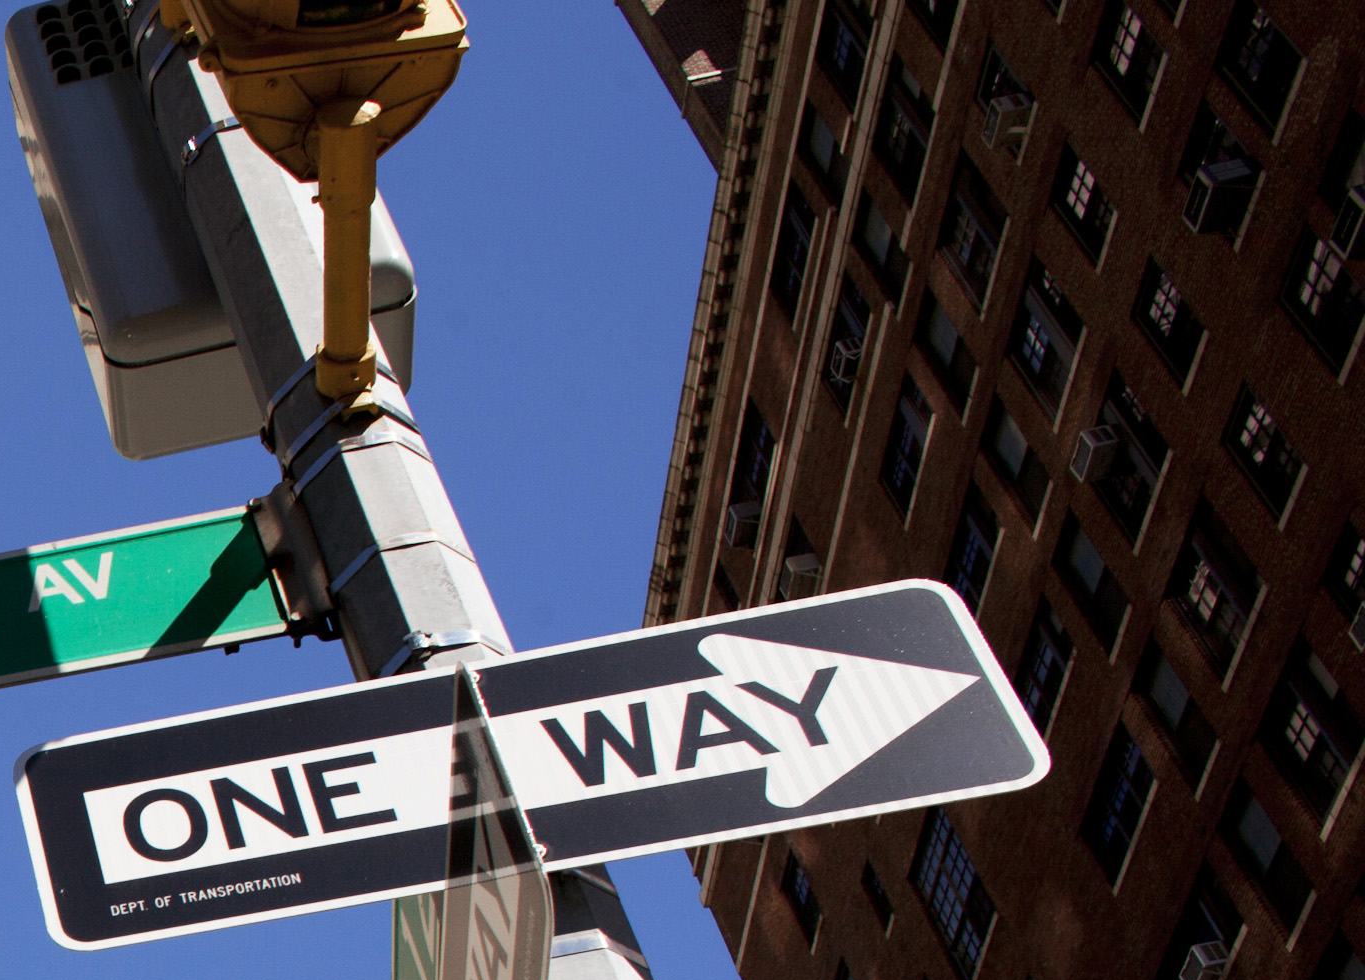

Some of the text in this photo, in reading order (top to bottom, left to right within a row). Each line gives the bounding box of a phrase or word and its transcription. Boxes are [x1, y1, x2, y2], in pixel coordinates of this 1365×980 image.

[27, 551, 114, 613] AV
[122, 751, 398, 863] ONE
[539, 665, 839, 788] WAY
[110, 872, 302, 917] DEPT. OF TRANSPORTATION
